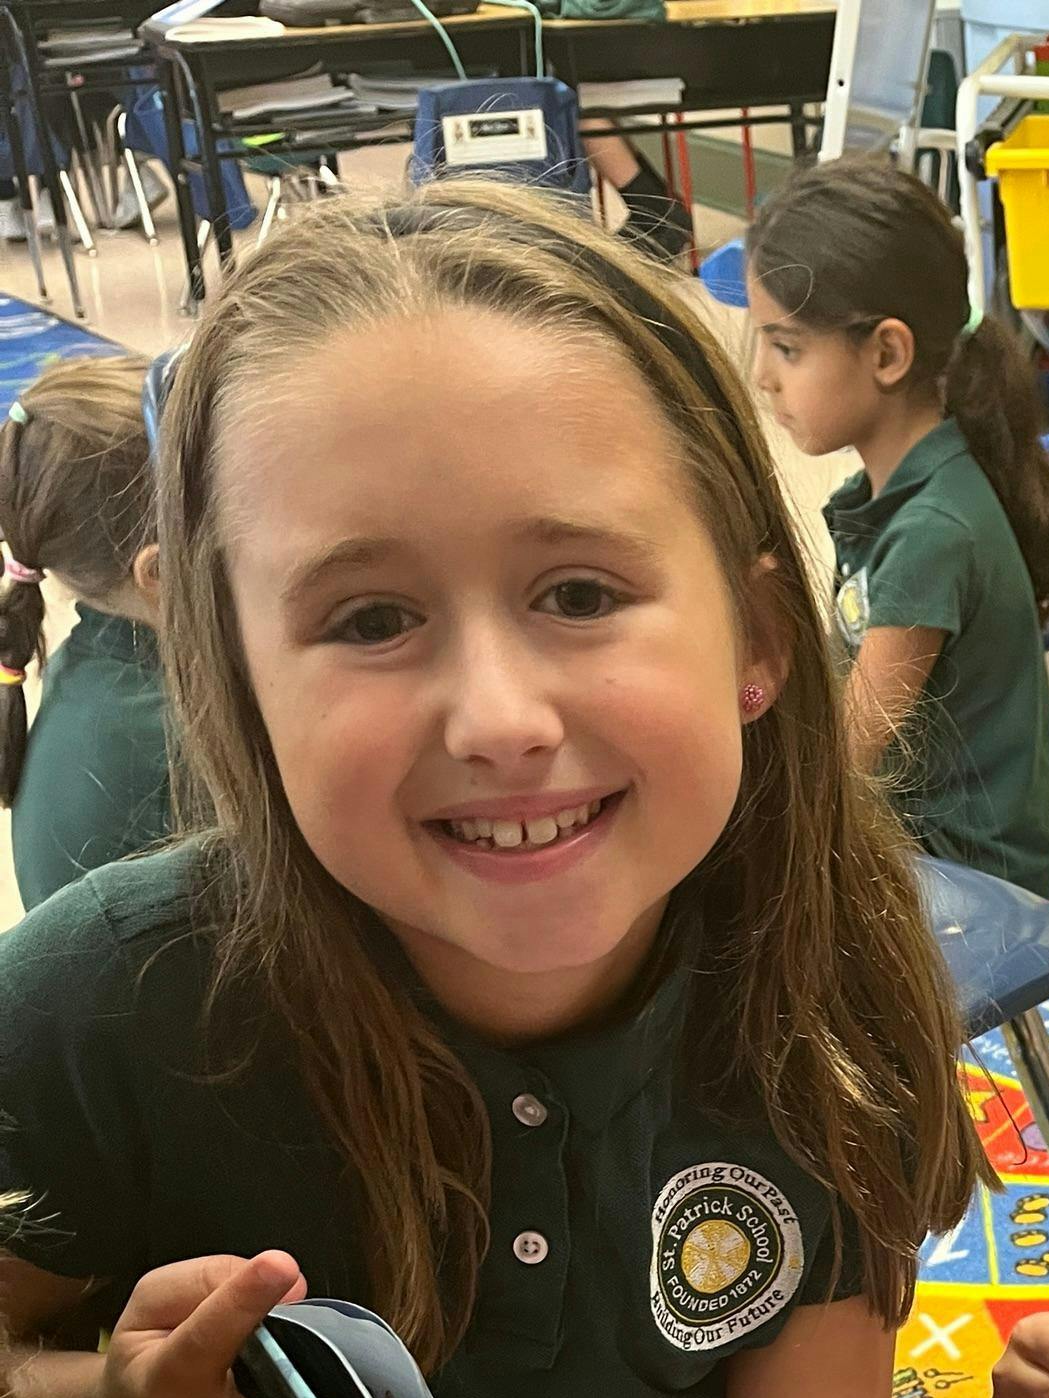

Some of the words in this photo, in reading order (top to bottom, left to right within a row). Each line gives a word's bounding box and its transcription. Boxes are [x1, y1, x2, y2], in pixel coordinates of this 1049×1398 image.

[655, 1166, 728, 1224] Honoring
[729, 1166, 765, 1191] Our
[762, 1188, 798, 1225] Past
[667, 1196, 734, 1241] Patrick
[662, 1243, 678, 1271] St.
[736, 1204, 773, 1264] School
[666, 1275, 729, 1312] FOUNDED
[729, 1269, 763, 1298] 1872
[693, 1326, 724, 1346] Our
[726, 1289, 785, 1334] Future
